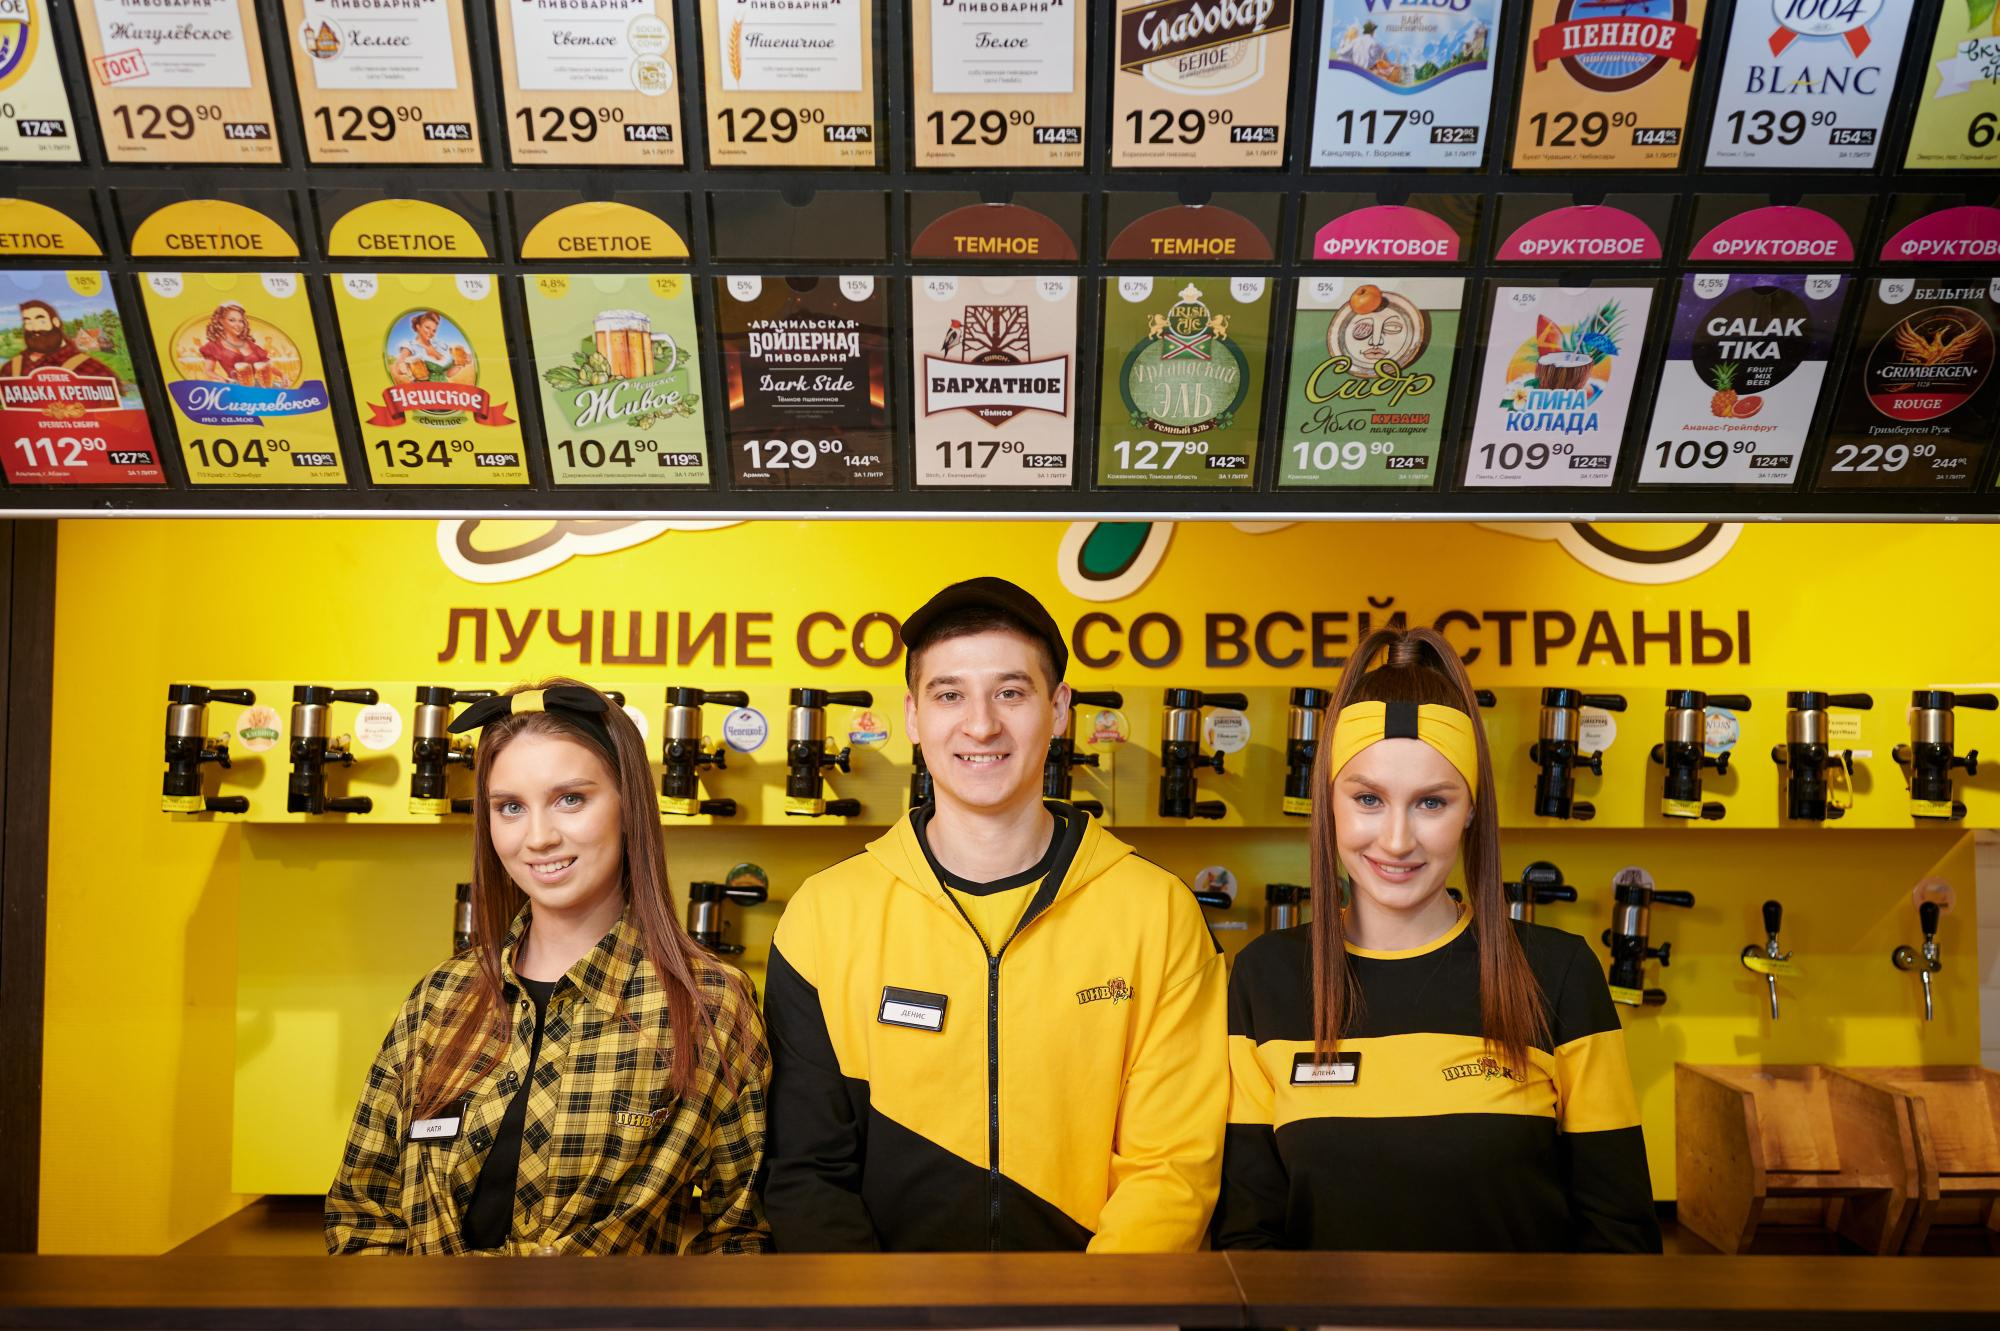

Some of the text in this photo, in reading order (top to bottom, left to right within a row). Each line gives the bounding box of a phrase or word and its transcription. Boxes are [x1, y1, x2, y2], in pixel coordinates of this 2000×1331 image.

[331, 0, 421, 8] ПИВОВАРНЯ
[538, 0, 628, 9] ПИВОВАРНЯ
[751, 1, 829, 9] ПИВОВАРНЯ
[958, 3, 1049, 12] ПИВОВАРНЯ
[110, 22, 233, 45] Жигулёвское
[348, 29, 411, 47] Хеллес
[552, 31, 617, 46] Светлое
[745, 32, 835, 49] Пшеничное
[975, 32, 1029, 48] Белое
[1562, 23, 1677, 50] ПЕННОЕ
[102, 56, 138, 78] ГОСТ
[1179, 47, 1229, 72] БЕЛОЕ
[1745, 65, 1881, 96] BLANC
[113, 104, 195, 139] 129
[314, 106, 396, 141] 129
[516, 107, 597, 142] 129
[718, 108, 798, 143] 129
[927, 110, 1007, 145] 129
[1126, 109, 1205, 144] 129
[1337, 110, 1408, 144] 117
[1530, 111, 1609, 147] 129
[1727, 110, 1806, 145] 139
[1968, 112, 2000, 148] 6
[166, 234, 263, 250] СВЕТЛОЕ
[357, 234, 456, 250] СВЕТЛОЕ
[558, 236, 651, 251] СВЕТЛОЕ
[954, 236, 1039, 254] ТЕМНОЕ
[1151, 238, 1236, 255] ТЕМНОЕ
[1323, 238, 1449, 256] ФРУКТОВОЕ
[1519, 238, 1645, 255] ФРУКТОВОЕ
[1712, 239, 1839, 256] ФРУКТОВОЕ
[154, 277, 179, 287] 4,5%
[269, 277, 290, 287] 11%
[464, 280, 483, 289] 11%
[656, 279, 677, 289] 12%
[737, 281, 752, 290] 5%
[846, 281, 867, 290] 15%
[929, 281, 954, 291] 4,5%
[1043, 281, 1063, 291] 12%
[1237, 282, 1258, 292] 16%
[1317, 282, 1333, 292] 5%
[1698, 279, 1724, 288] 4,5%
[1812, 279, 1832, 289] 12%
[1888, 284, 1904, 293] 6%
[1512, 293, 1536, 303] 4,5%
[1914, 288, 1986, 300] БЕЛЬГИЯ
[1171, 306, 1207, 318] IRISH
[752, 320, 855, 329] АРАМИЛЬСКАЯ
[1706, 317, 1807, 337] GALAK
[748, 329, 861, 358] БОЙЛЕРНАЯ
[1718, 341, 1781, 360] TIKA
[764, 353, 847, 363] ПИВОВАРНЯ
[1882, 366, 1973, 378] GRIMBERGEN
[759, 374, 855, 392] Dark Side
[931, 377, 1061, 394] БАРХАТНОЕ
[1305, 355, 1436, 407] Сидр
[4, 385, 115, 403] ДЯДЬКА КРЕПЫШ
[188, 386, 321, 416] Жигулевское
[389, 388, 483, 409] Чешское
[1153, 382, 1213, 418] ЭЛЬ
[1527, 390, 1586, 410] ПИНА
[574, 380, 682, 427] Живое
[1893, 399, 1943, 410] ROUGE
[419, 416, 463, 426] светлое
[979, 409, 1013, 417] тёмное
[1371, 413, 1430, 424] КУБАНИ
[1153, 422, 1210, 435] темный эль
[1369, 426, 1427, 436] полусладкое
[1506, 412, 1599, 435] КОЛАДА
[1682, 424, 1779, 433] Ананас-Грейпфрут
[1869, 425, 1951, 436] Гримберген Руж
[14, 437, 88, 467] 112
[189, 438, 270, 468] 104
[375, 440, 453, 468] 134
[557, 440, 636, 468] 104
[743, 439, 817, 469] 129
[936, 441, 1001, 469] 117
[1113, 441, 1185, 470] 127
[1292, 441, 1367, 470] 109
[1480, 443, 1550, 470] 109
[1655, 440, 1729, 469] 109
[1831, 444, 1910, 472] 229
[437, 607, 774, 667] ЛУЧШИЕ
[1072, 612, 1182, 669] СО
[1433, 609, 1750, 667] СТРАНЫ
[901, 1009, 926, 1020] ДЕНИС
[1311, 1069, 1336, 1077] АЛЕНА
[427, 1125, 442, 1133] КАТЯ
